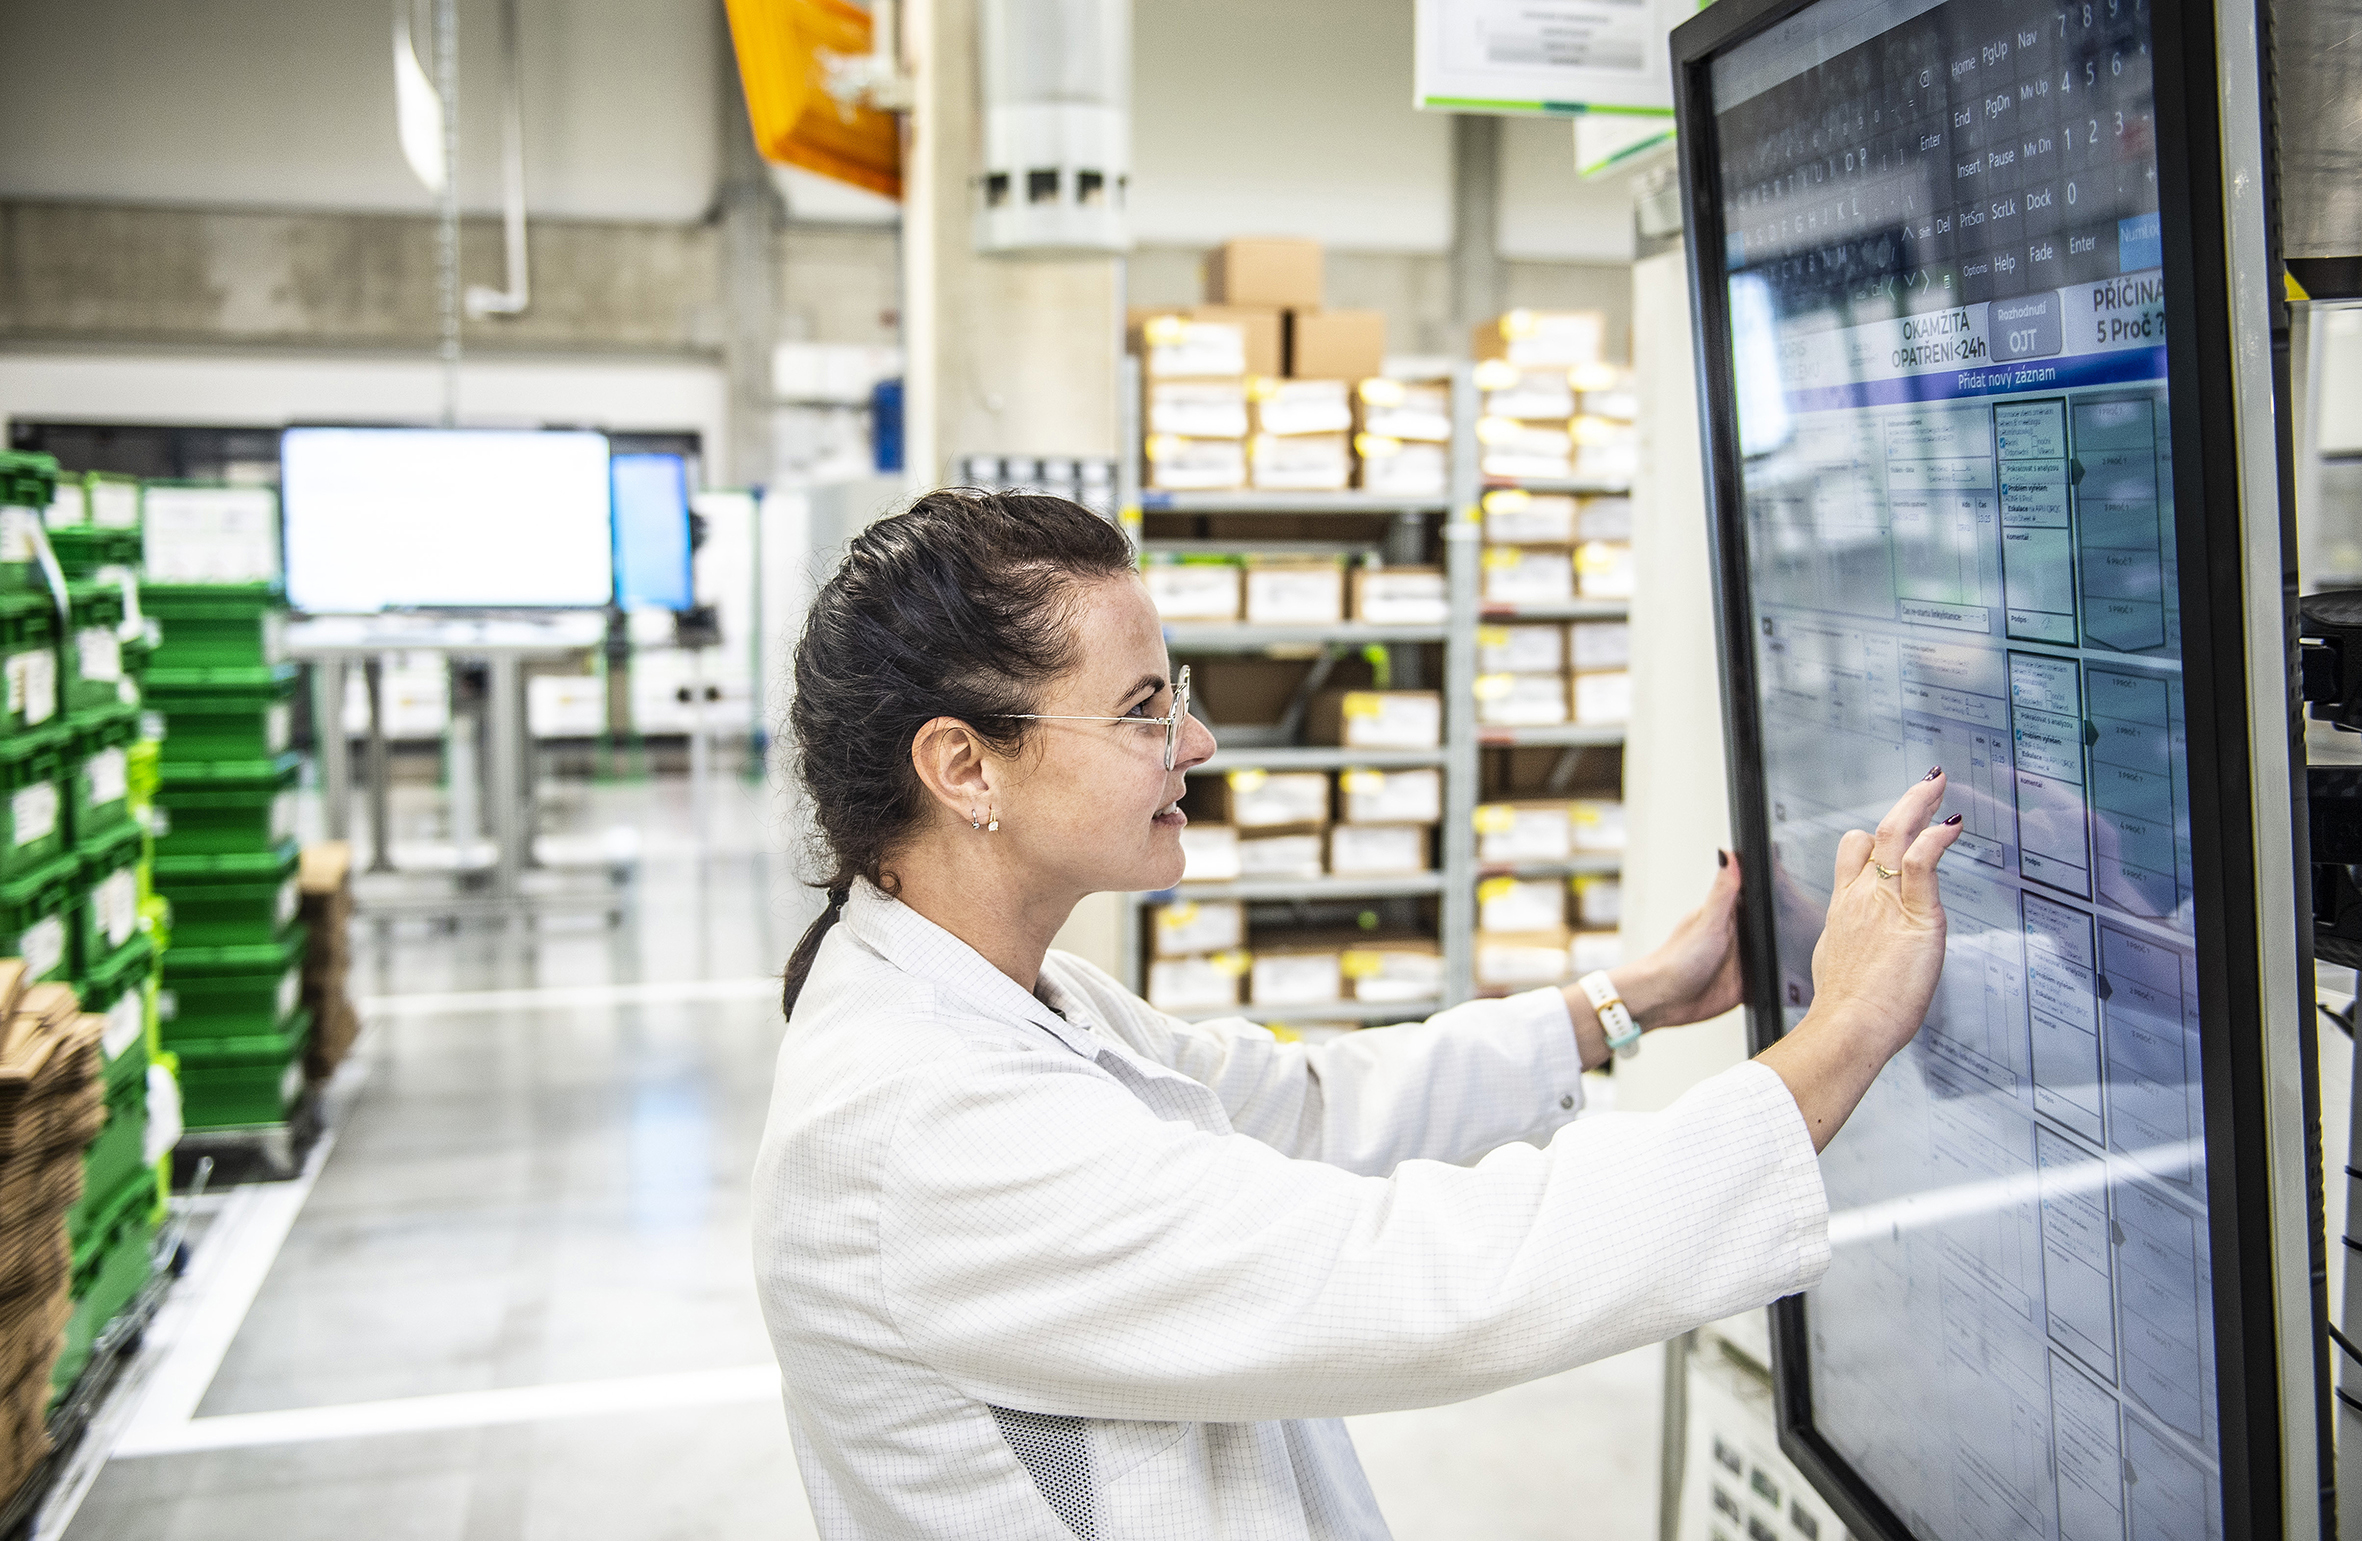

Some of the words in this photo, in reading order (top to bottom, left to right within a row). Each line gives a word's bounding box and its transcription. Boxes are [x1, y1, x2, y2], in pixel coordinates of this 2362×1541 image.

[2058, 14, 2066, 37] 7
[2083, 4, 2092, 28] 8
[2018, 31, 2037, 49] Nav
[1982, 41, 2008, 66] PgUp
[2111, 52, 2122, 76] 6
[1951, 56, 1976, 77] Home
[2086, 61, 2095, 85] 5
[2020, 86, 2034, 101] Mv
[2035, 79, 2048, 97] Up
[2061, 71, 2070, 93] 4
[1954, 107, 1971, 128] End
[1985, 94, 2010, 119] PgDn
[2089, 119, 2098, 144] 2
[2115, 111, 2123, 135] 3
[1920, 132, 1941, 151] Enter
[2023, 143, 2037, 158] Mv
[2038, 138, 2051, 154] Dn
[2064, 128, 2071, 150] 1
[1957, 158, 1981, 179] Insert
[1988, 149, 2015, 169] Pause
[2026, 188, 2052, 211] Dock
[2067, 182, 2076, 205] 0
[1960, 210, 1985, 228] PrtScn
[1992, 199, 2016, 220] ScrLk
[1936, 216, 1950, 235] Del
[2029, 243, 2053, 263] Fade
[2069, 236, 2096, 255] Enter
[1963, 262, 1987, 278] Options
[1994, 255, 2016, 274] Help
[1998, 301, 2047, 320] Rozhodnutí
[1903, 305, 1970, 340] OKAMŽITÁ
[2097, 320, 2107, 343] 5
[2111, 311, 2152, 341] Proč
[2009, 328, 2037, 352] OJT
[1958, 373, 1986, 390] Přidat
[1989, 367, 2012, 388] nový
[2015, 366, 2056, 384] záznam
